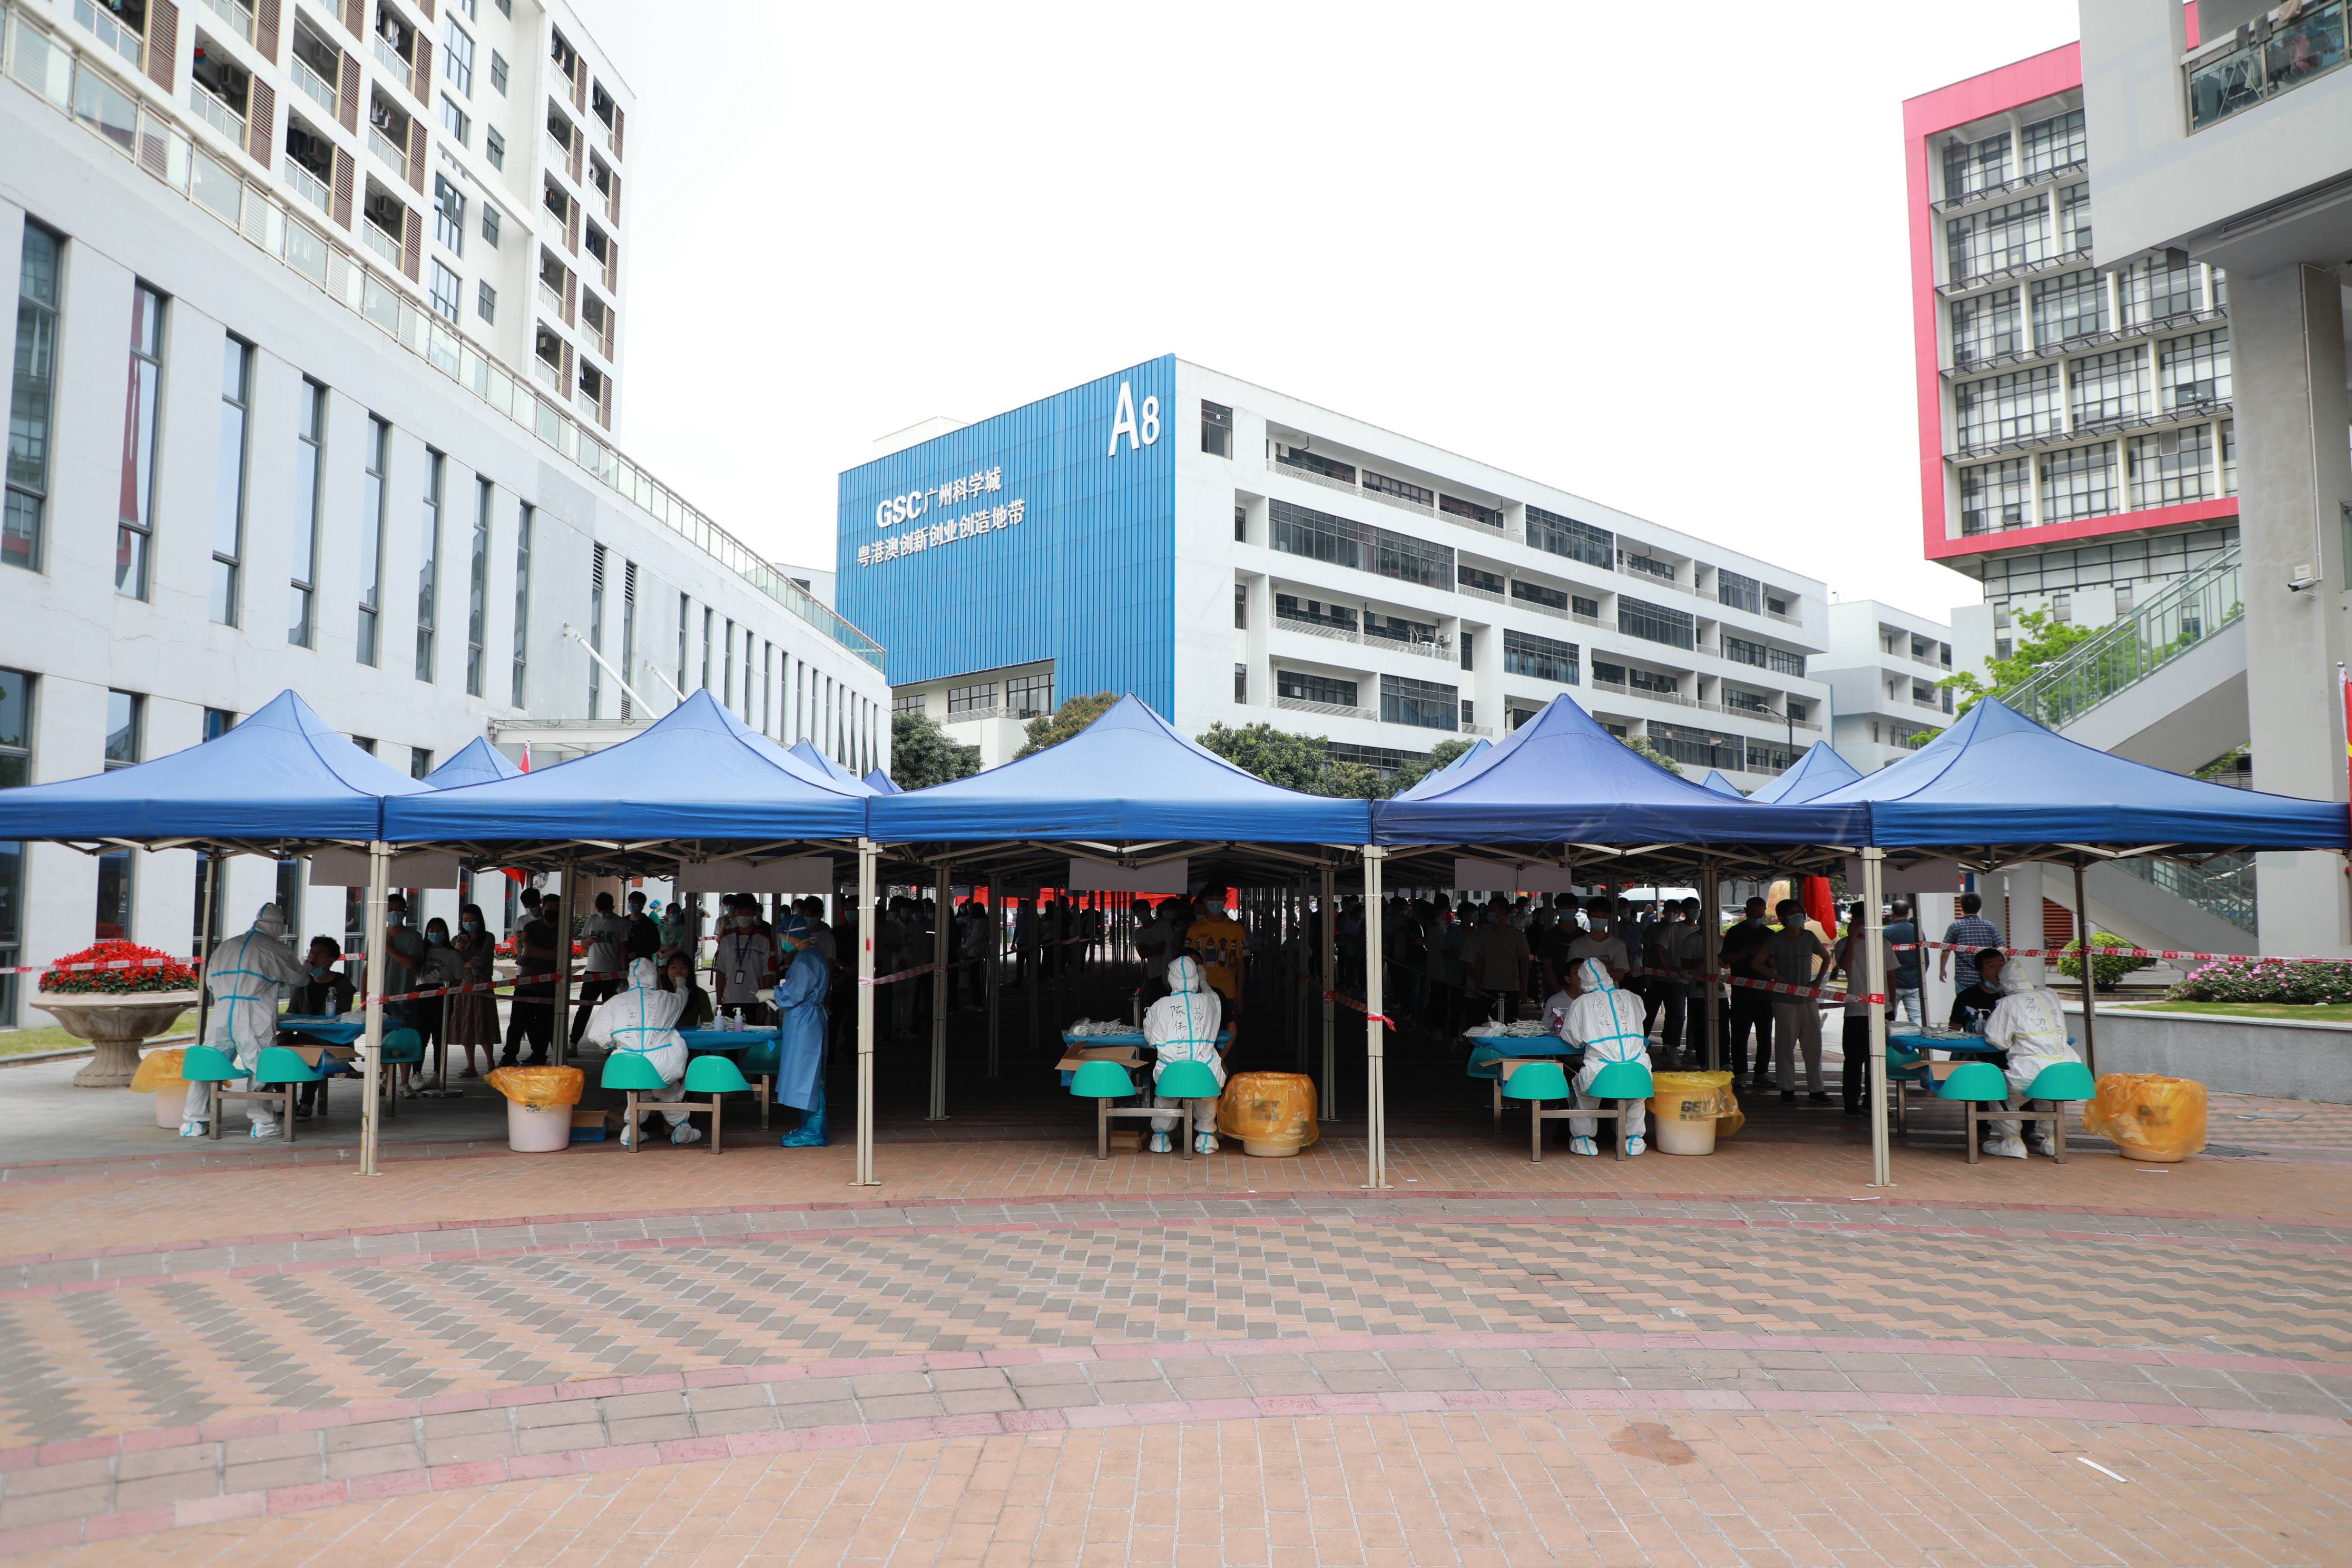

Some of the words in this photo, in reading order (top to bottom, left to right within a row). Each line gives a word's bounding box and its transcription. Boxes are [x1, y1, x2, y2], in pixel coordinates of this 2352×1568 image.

[1108, 380, 1160, 457] A8
[876, 491, 922, 528] GSC
[923, 466, 1002, 514] 广州科学城
[857, 498, 1025, 568] 粤港澳创新创业创造地带
